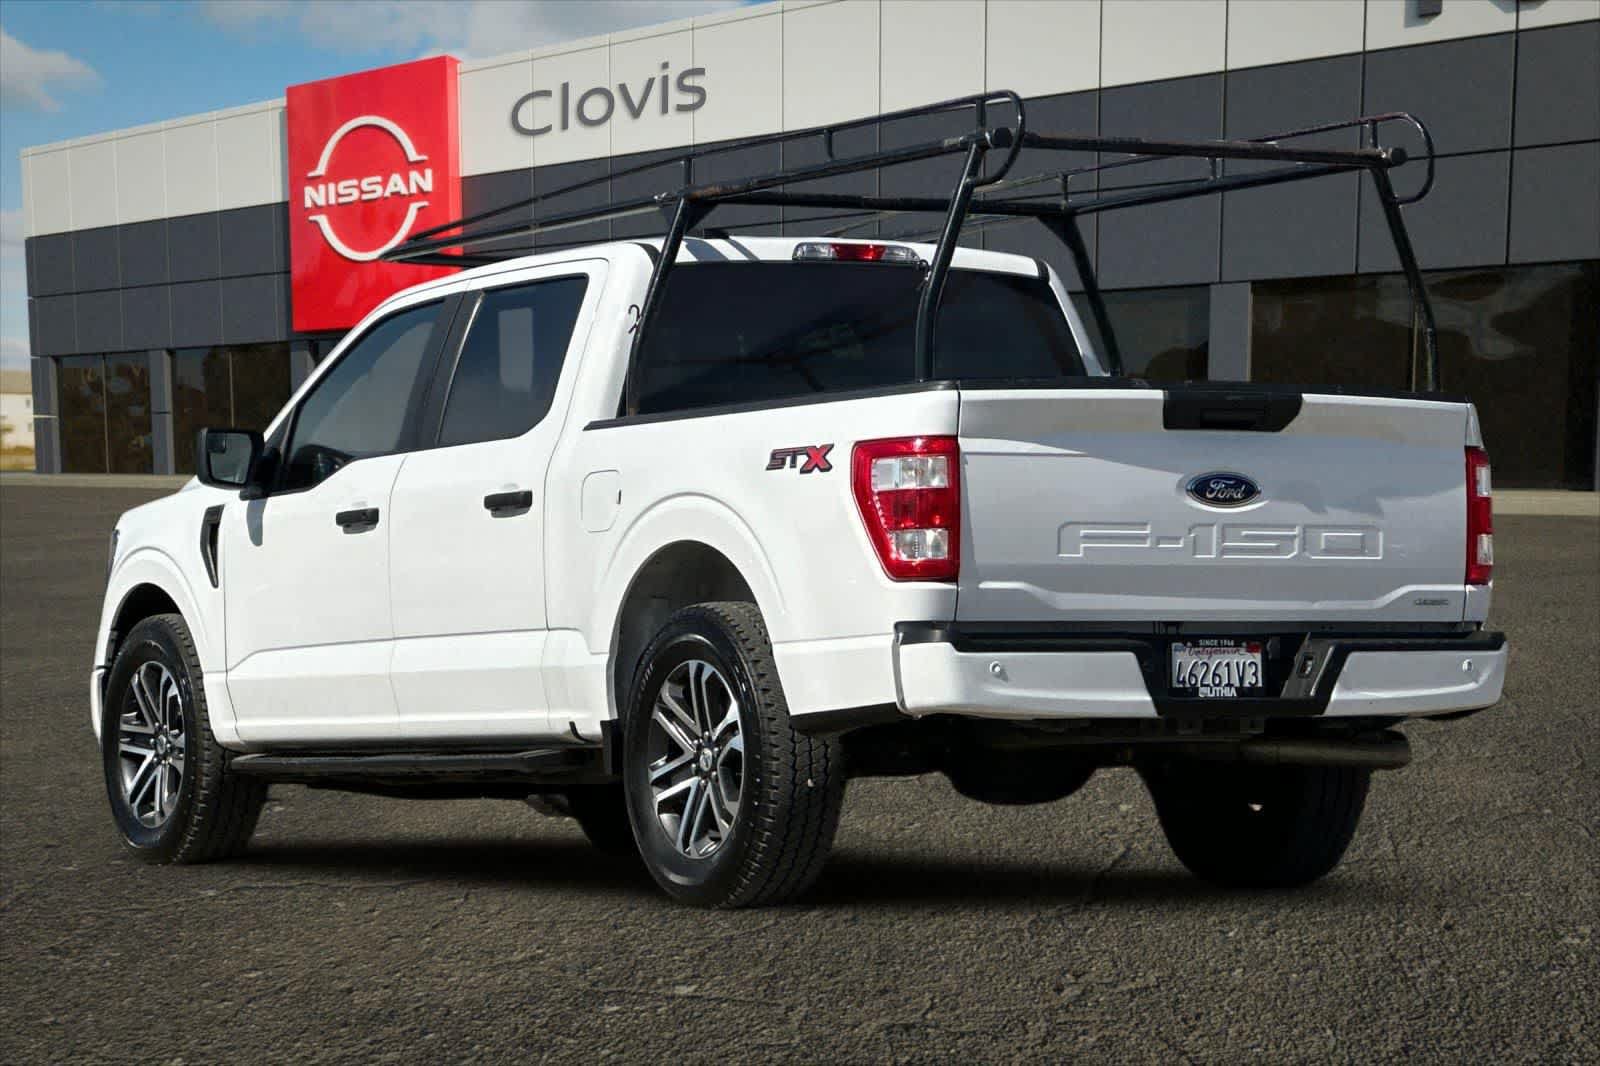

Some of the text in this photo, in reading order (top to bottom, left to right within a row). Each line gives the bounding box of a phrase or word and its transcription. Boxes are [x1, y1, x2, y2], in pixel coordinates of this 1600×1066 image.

[510, 61, 707, 136] Clovis
[303, 168, 433, 208] NISSAN
[765, 444, 834, 474] STX
[1206, 479, 1246, 498] Ford
[1058, 522, 1383, 560] F-150
[1188, 647, 1244, 659] California
[1176, 660, 1258, 687] 46261V3
[1207, 687, 1236, 697] LITHIA
